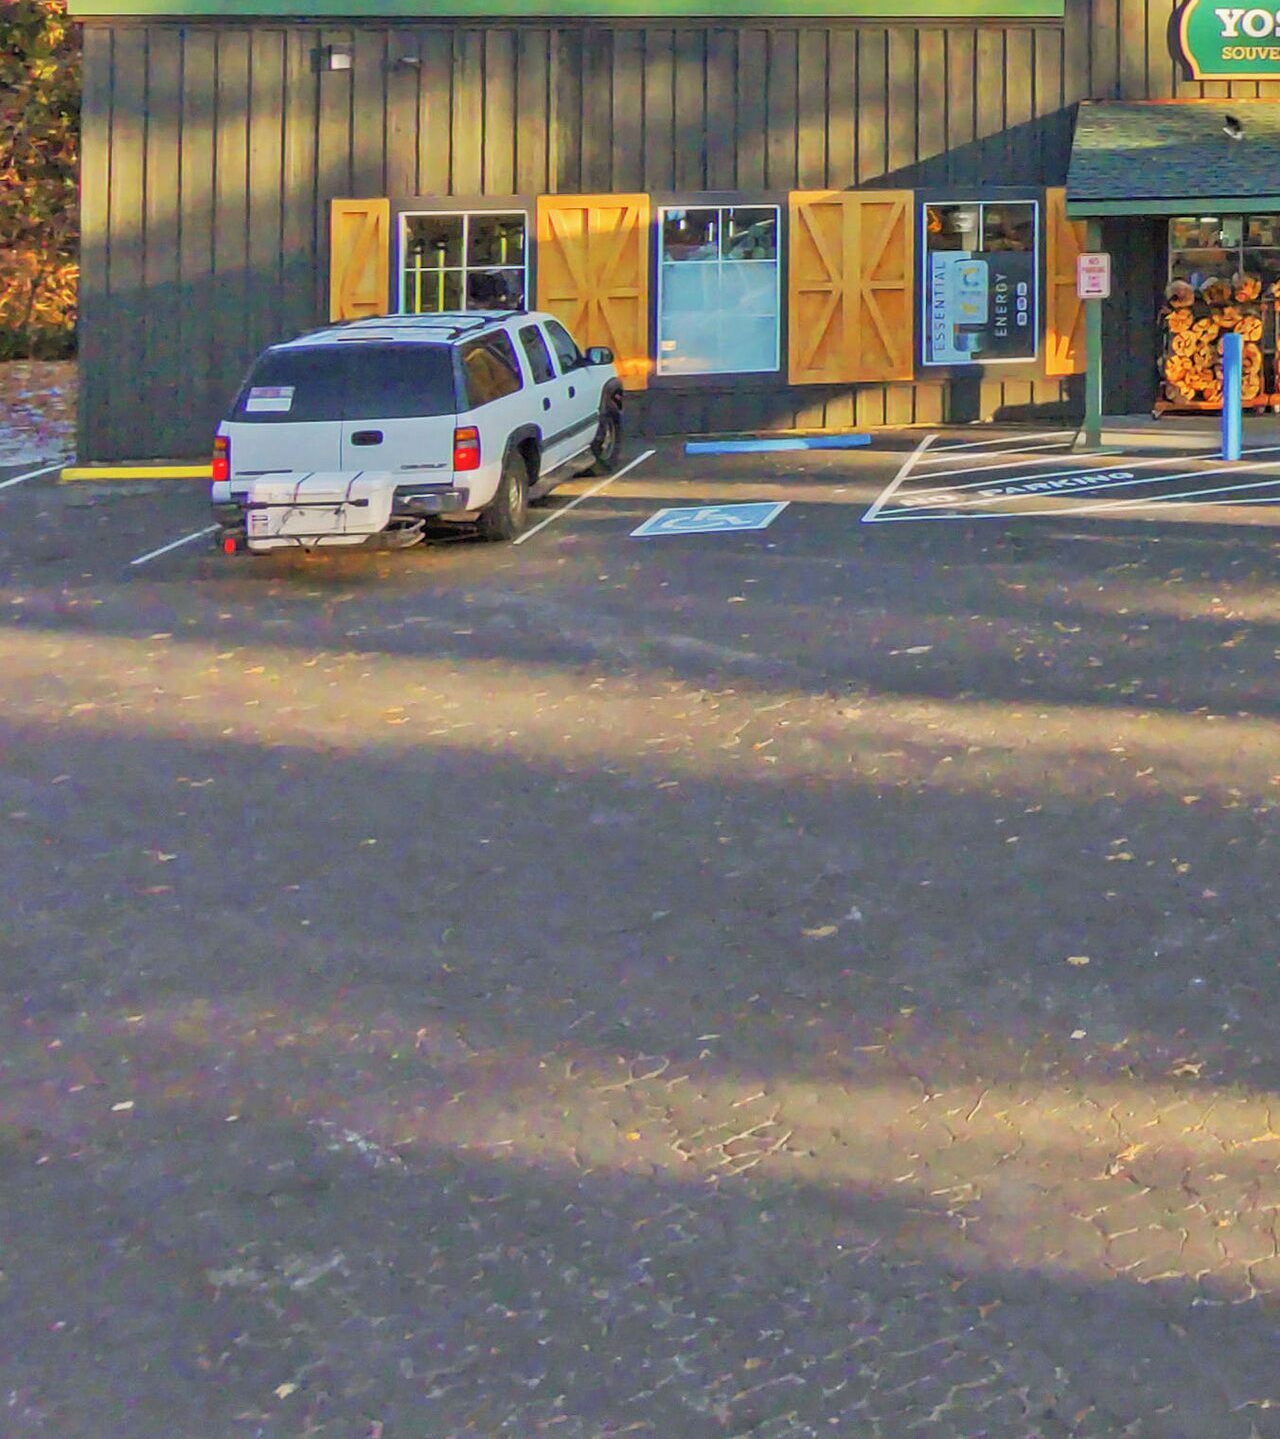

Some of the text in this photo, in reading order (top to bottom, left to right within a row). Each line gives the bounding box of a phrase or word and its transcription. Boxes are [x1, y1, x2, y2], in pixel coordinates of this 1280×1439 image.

[934, 260, 946, 352] ESSENTIAL
[995, 273, 1008, 337] ENERGY
[899, 471, 1135, 507] NO PARKING
